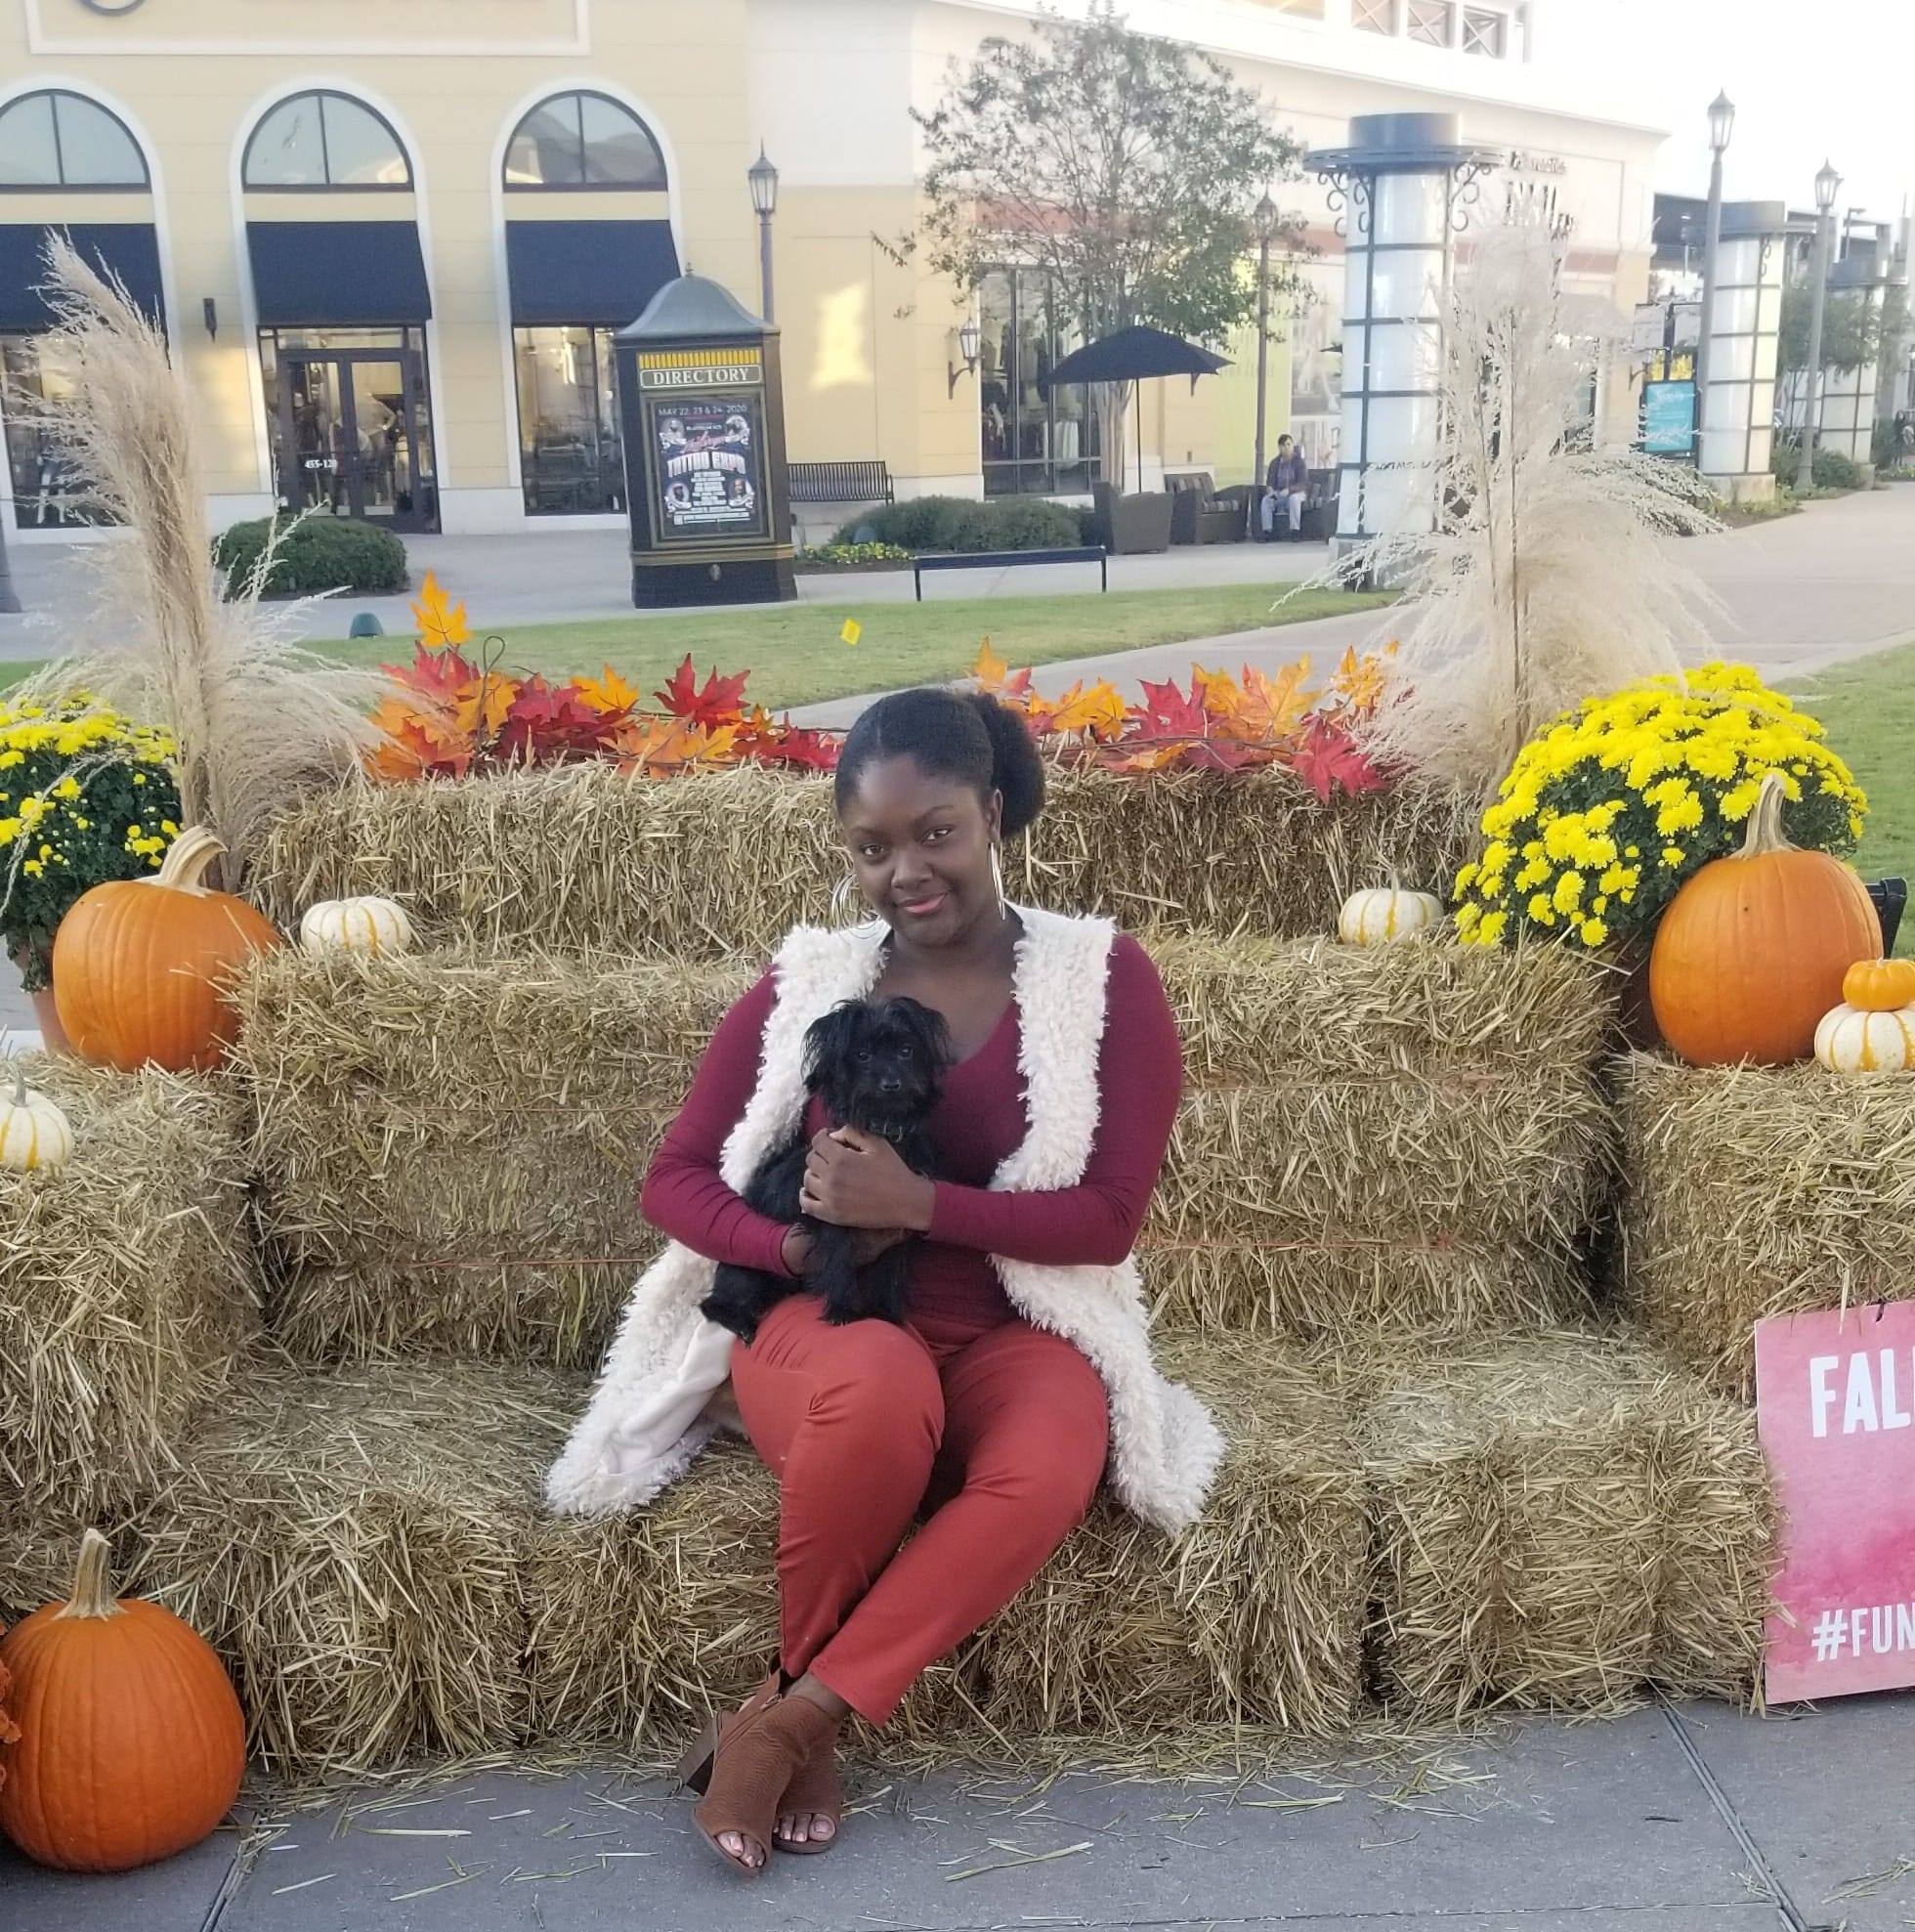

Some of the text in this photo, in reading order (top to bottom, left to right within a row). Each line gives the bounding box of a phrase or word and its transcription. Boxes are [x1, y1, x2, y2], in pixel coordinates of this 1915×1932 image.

[654, 367, 748, 385] DIRECTORY
[1809, 1346, 1915, 1438] FAL
[1811, 1603, 1915, 1661] #FUN
